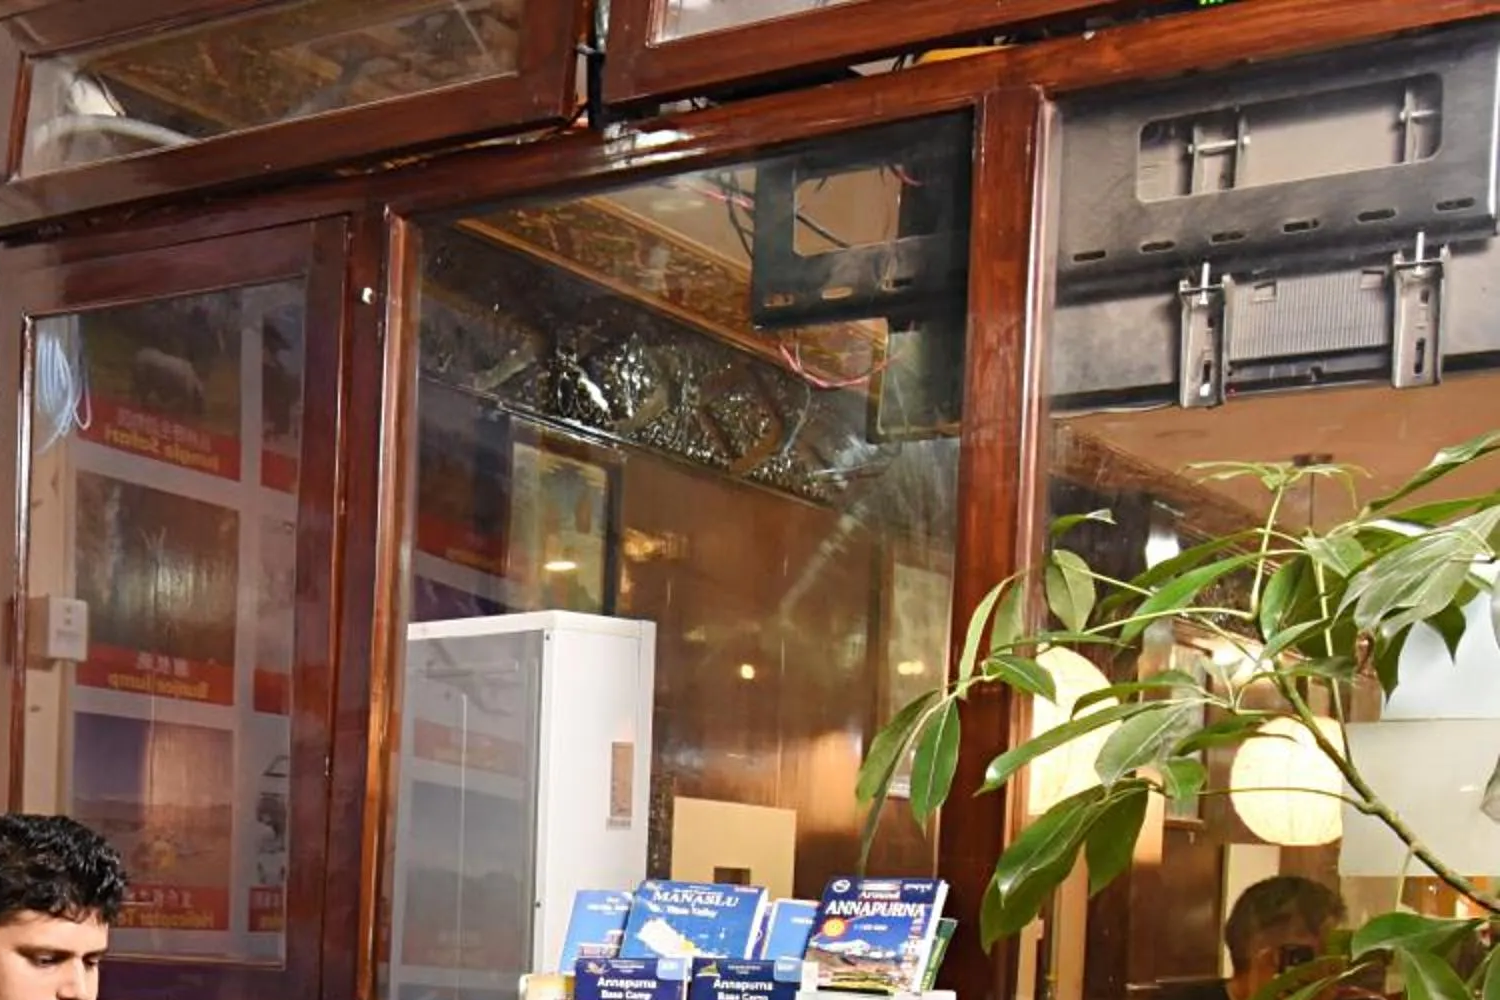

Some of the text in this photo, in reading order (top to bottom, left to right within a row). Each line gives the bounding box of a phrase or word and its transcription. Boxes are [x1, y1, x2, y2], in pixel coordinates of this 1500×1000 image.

[653, 890, 740, 907] MANASLU
[825, 899, 925, 917] ANNAPURNA
[597, 977, 657, 989] Annapurna
[713, 979, 773, 991] Annapurna
[601, 990, 623, 999] Base
[717, 992, 740, 1000] Base
